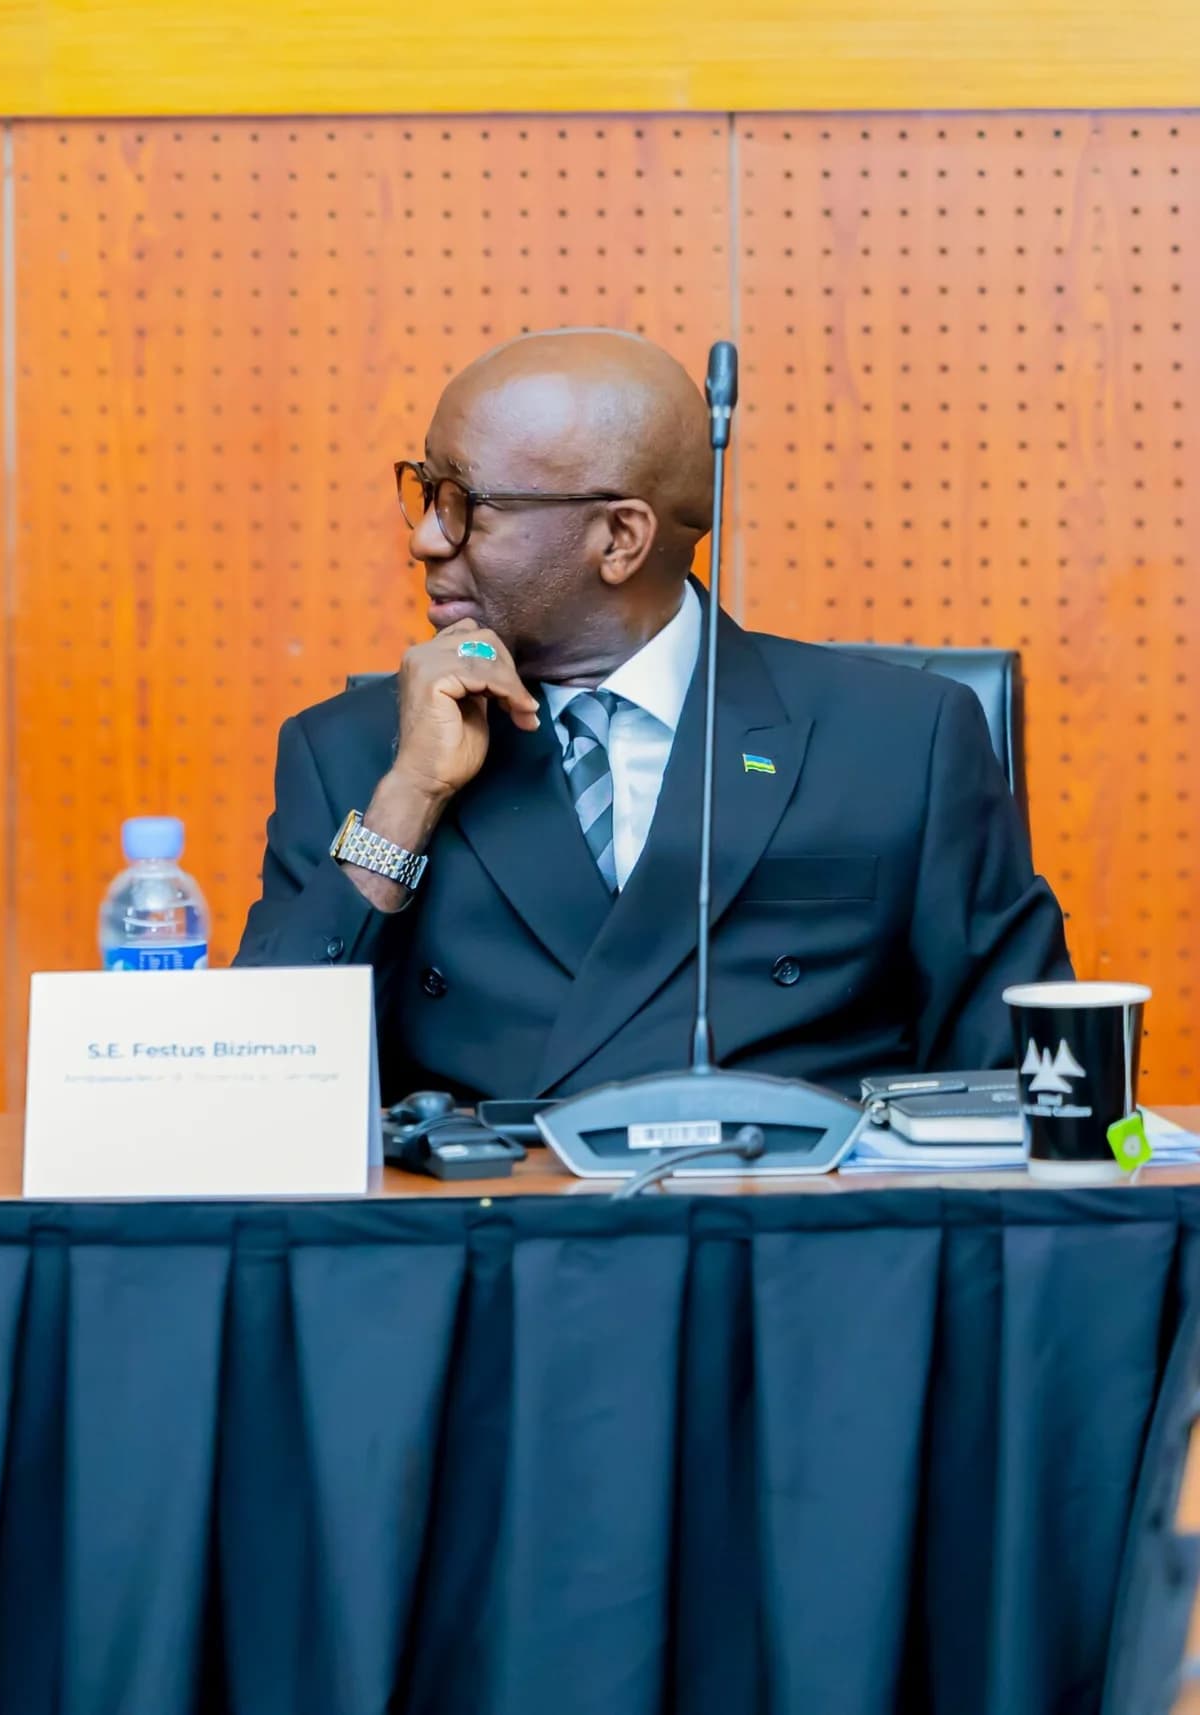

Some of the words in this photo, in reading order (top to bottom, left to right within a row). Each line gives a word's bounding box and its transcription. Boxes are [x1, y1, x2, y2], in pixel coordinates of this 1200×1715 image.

[87, 1042, 125, 1059] S.E.
[132, 1042, 205, 1058] Festus
[213, 1041, 317, 1057] Bizimana
